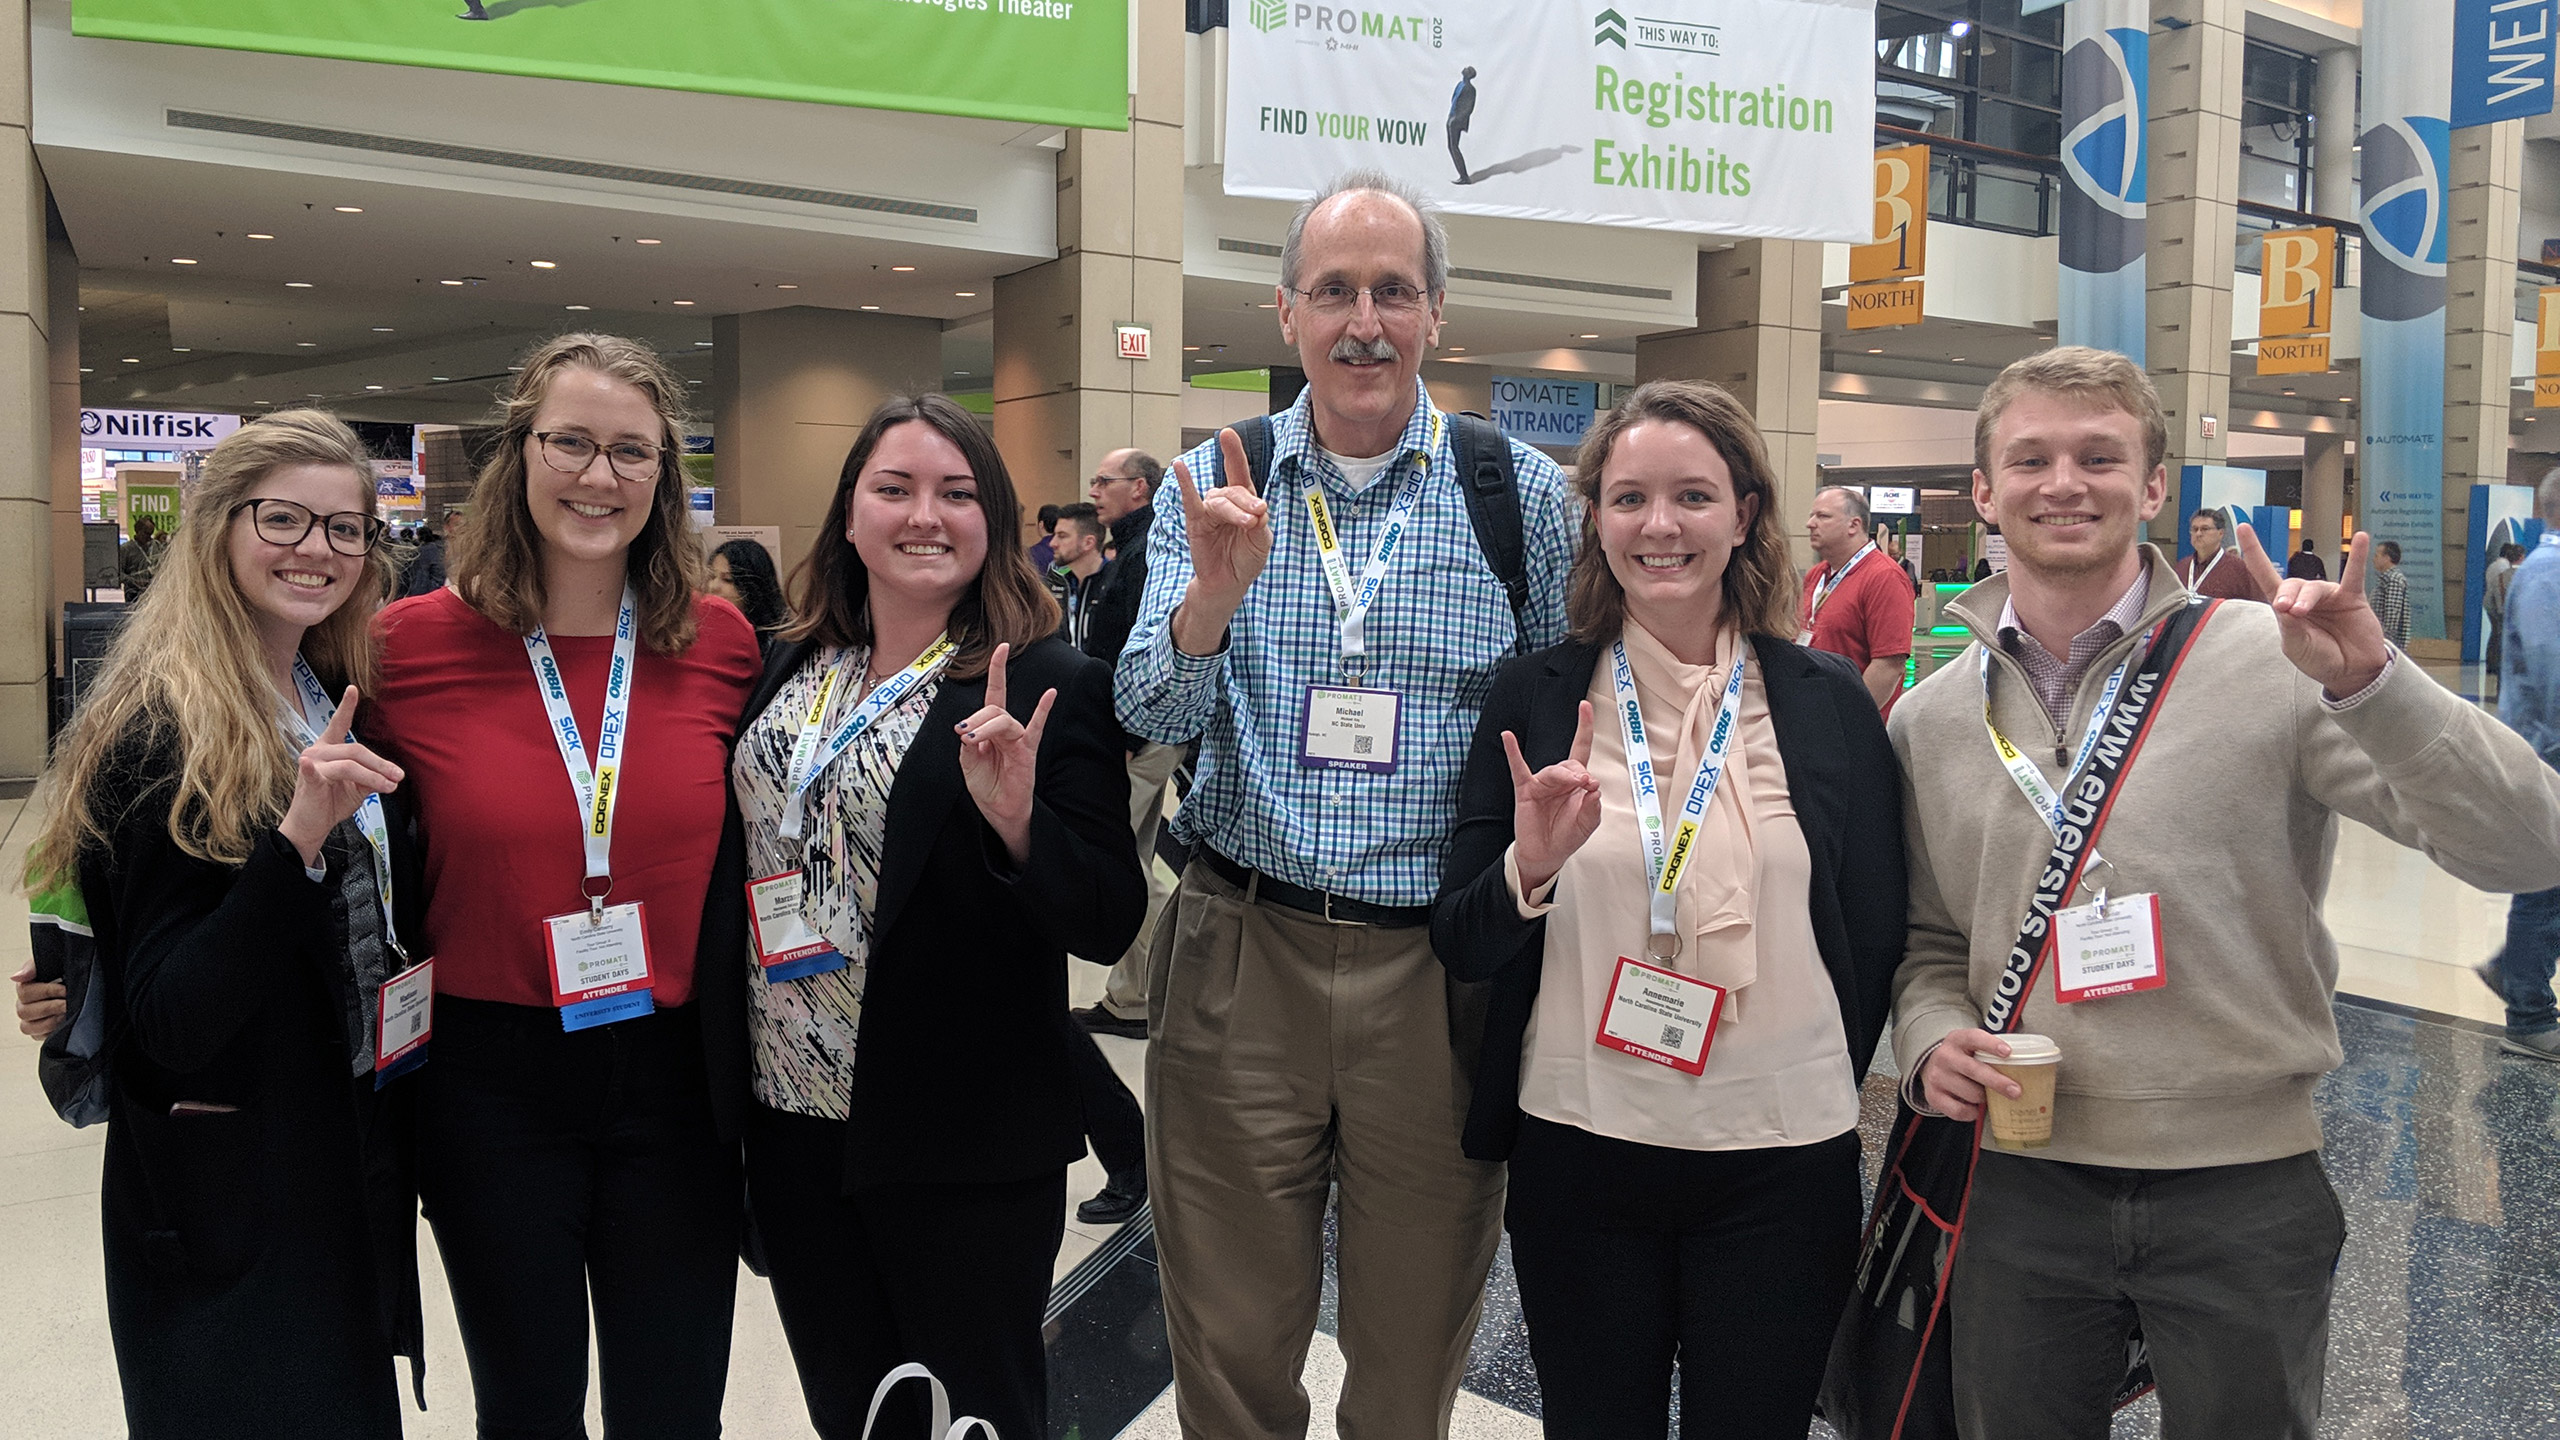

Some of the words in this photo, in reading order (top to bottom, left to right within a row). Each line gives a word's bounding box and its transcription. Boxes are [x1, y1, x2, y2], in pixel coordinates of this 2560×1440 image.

[1294, 3, 1424, 42] PROMAT
[1432, 17, 1443, 49] 2019
[1637, 25, 1666, 42] THIS
[1669, 29, 1698, 45] WAY
[1701, 33, 1719, 49] TO:
[1594, 64, 1833, 134] Registration
[1260, 106, 1308, 136] FIND
[1315, 111, 1370, 141] YOUR
[1376, 117, 1428, 147] WOW
[1593, 138, 1751, 197] Exhibits
[1850, 289, 1915, 311] NORTH
[1120, 332, 1146, 353] EXIT
[2261, 343, 2323, 361] NORTH
[1491, 381, 1579, 406] TOMATE
[106, 414, 214, 438] Nilfisk
[2203, 422, 2215, 434] EXIT
[2375, 434, 2435, 445] AUTOMATE
[131, 494, 170, 513] FIND
[1395, 470, 1424, 518] OPEX
[133, 515, 177, 531] YUR
[1311, 496, 1333, 550] COGNEX
[1377, 522, 1401, 565] ORBIS
[1328, 562, 1348, 608] PROMAT
[1357, 577, 1379, 609] SICK
[618, 606, 631, 640] SICK
[916, 636, 953, 668] GNEX
[1613, 640, 1633, 692] OPEX
[540, 655, 565, 700] ORBIS
[609, 654, 625, 699] ORBIS
[869, 672, 915, 713] OPEX
[1728, 659, 1744, 696] SICK
[810, 672, 834, 723] COGNEX
[1327, 692, 1358, 701] PROMAT
[1335, 707, 1364, 717] Michael
[560, 716, 581, 751] SICK
[600, 708, 621, 759] OPEX
[831, 714, 868, 753] ORBIS
[1626, 699, 1645, 744] ORBIS
[1709, 708, 1732, 755] ORBIS
[791, 739, 811, 782] PROMAT
[1328, 760, 1368, 770] SPEAKER
[797, 764, 822, 795] SICK
[1637, 760, 1656, 796] SICK
[1685, 761, 1717, 816] OPEX
[595, 770, 612, 834] COGNEX
[1650, 831, 1664, 878] PROMA
[1663, 825, 1694, 891] COGNEX
[765, 879, 794, 892] PROMAT
[589, 955, 623, 968] PROMAT
[782, 945, 823, 961] ATTENDEE
[2081, 962, 2114, 975] STUDENT
[2116, 959, 2135, 969] DAYS
[2092, 945, 2129, 957] PROMAT
[580, 973, 610, 985] STUDENT
[612, 969, 630, 979] DAYS
[582, 984, 628, 1000] ATTENDEE
[1640, 971, 1675, 987] PROMAT
[2083, 982, 2134, 998] ATTENDEE
[574, 1006, 611, 1020] UNIVERSITY
[612, 1001, 641, 1013] STUDENT
[1618, 994, 1634, 1006] North
[1634, 1000, 1657, 1013] Carolina
[1658, 1007, 1673, 1018] State
[1674, 1012, 1702, 1029] University
[1642, 987, 1685, 1008] Annemarie
[1623, 1043, 1674, 1066] ATTENDEE
